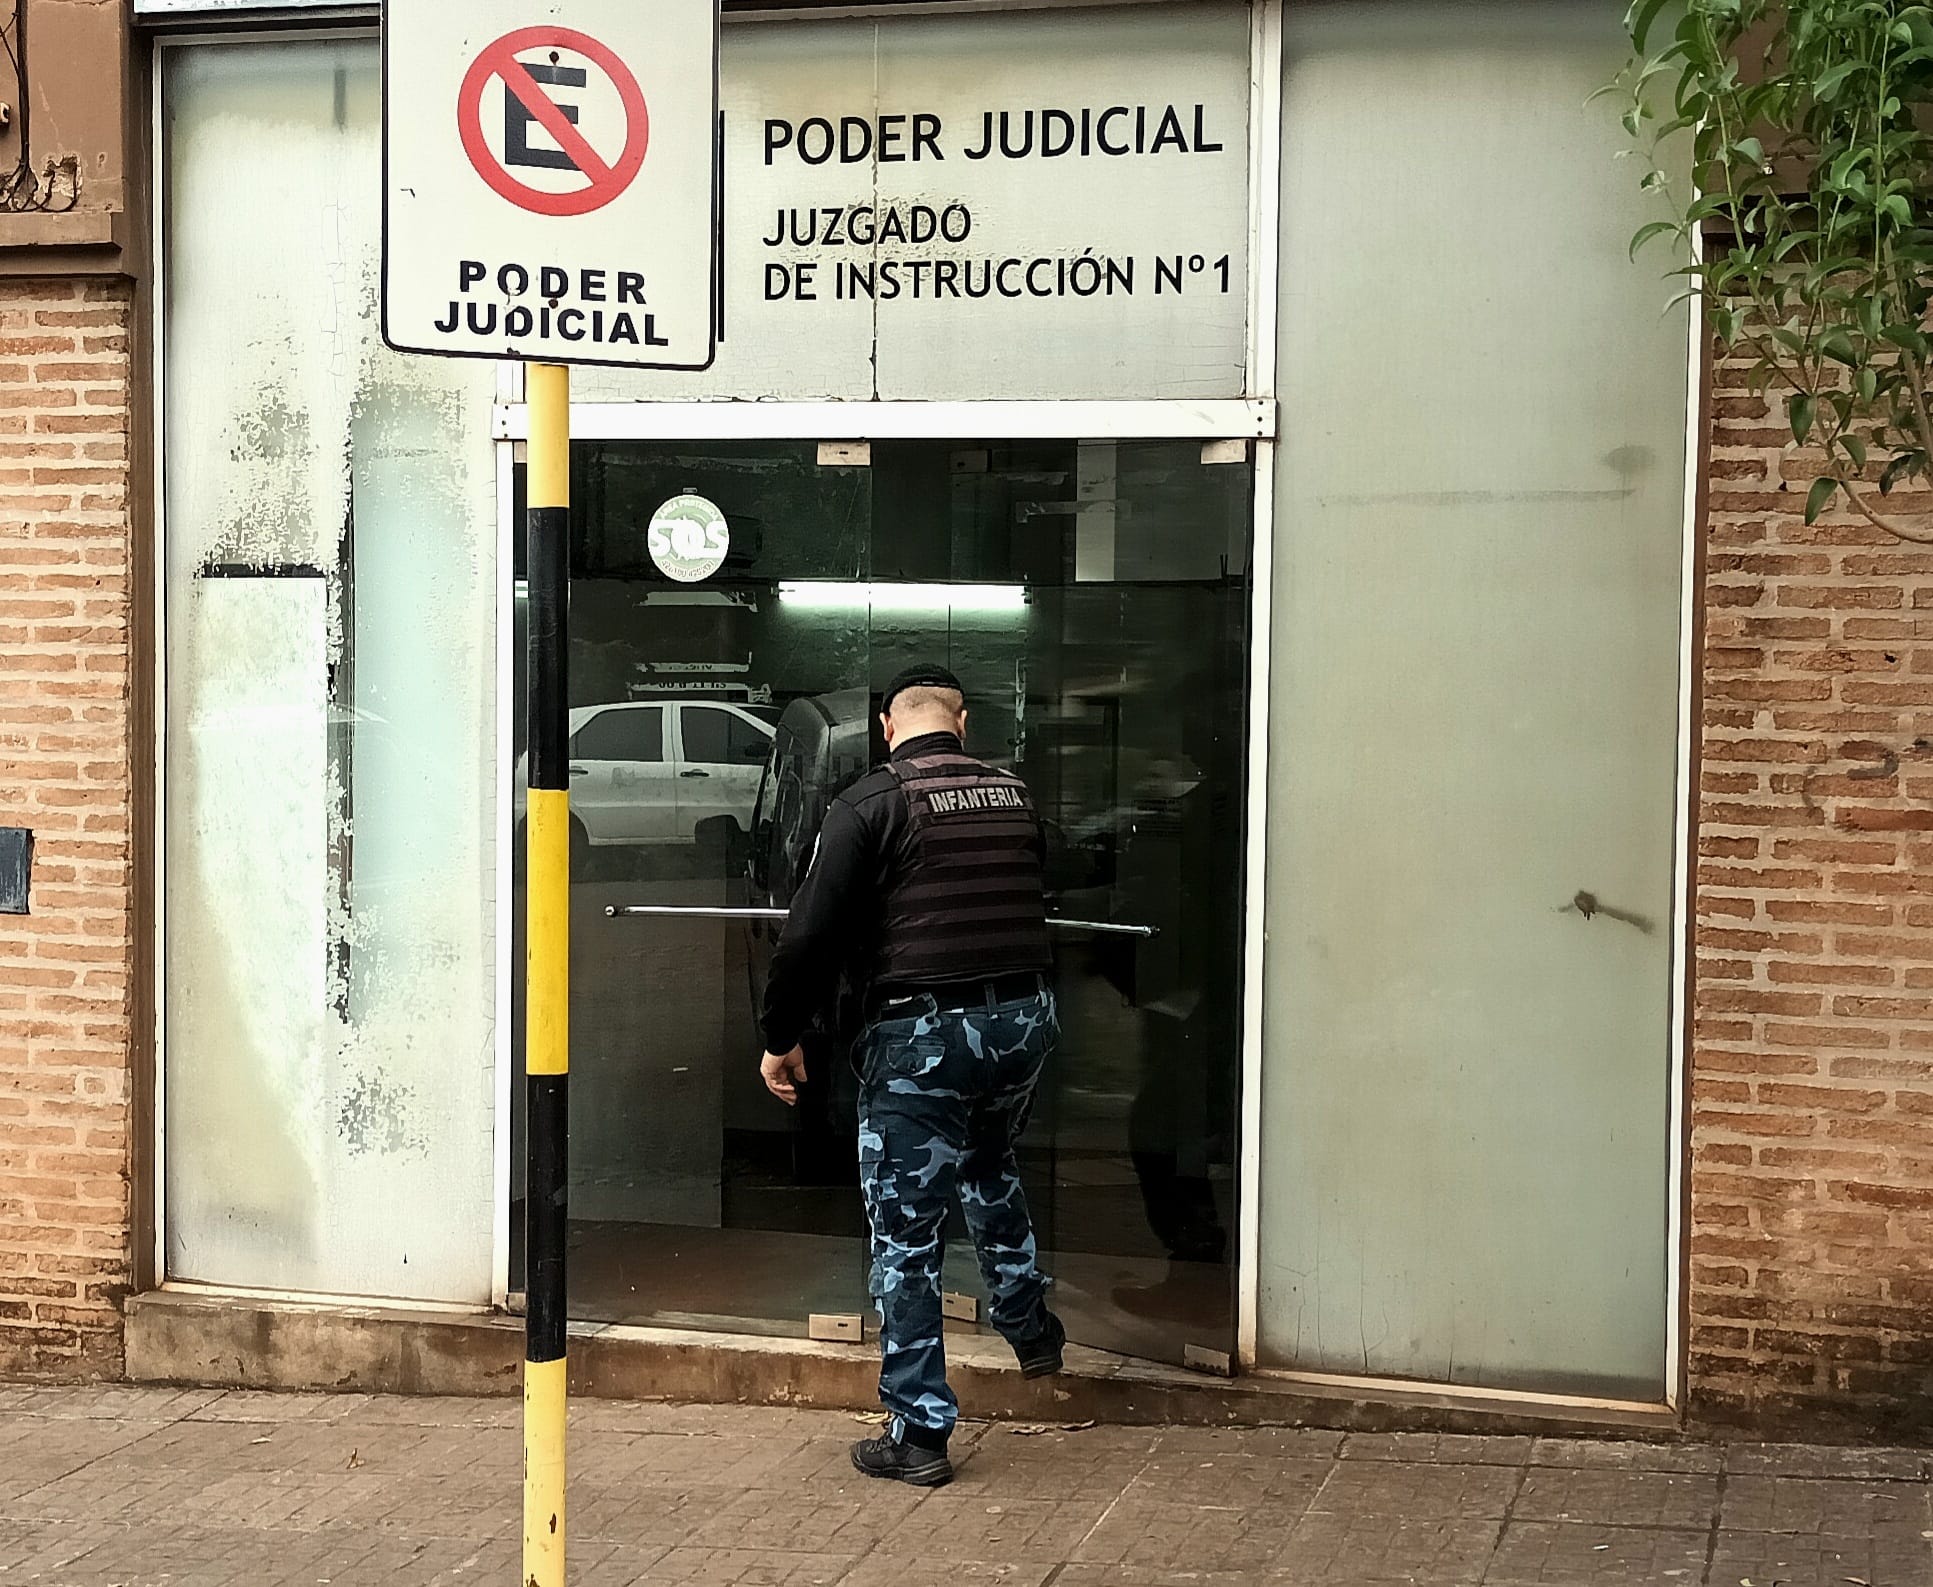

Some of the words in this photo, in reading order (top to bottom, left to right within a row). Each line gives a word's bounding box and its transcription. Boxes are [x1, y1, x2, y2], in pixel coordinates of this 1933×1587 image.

[764, 113, 945, 166] PODER
[963, 104, 1224, 160] JUDICIAL
[762, 204, 972, 247] JUZGADO
[459, 260, 647, 305] PODER
[764, 264, 818, 301] DE
[836, 247, 1135, 300] INSTRUCCIÓN
[433, 301, 669, 347] JUDICIAL
[928, 787, 1024, 813] INFANTERIA
